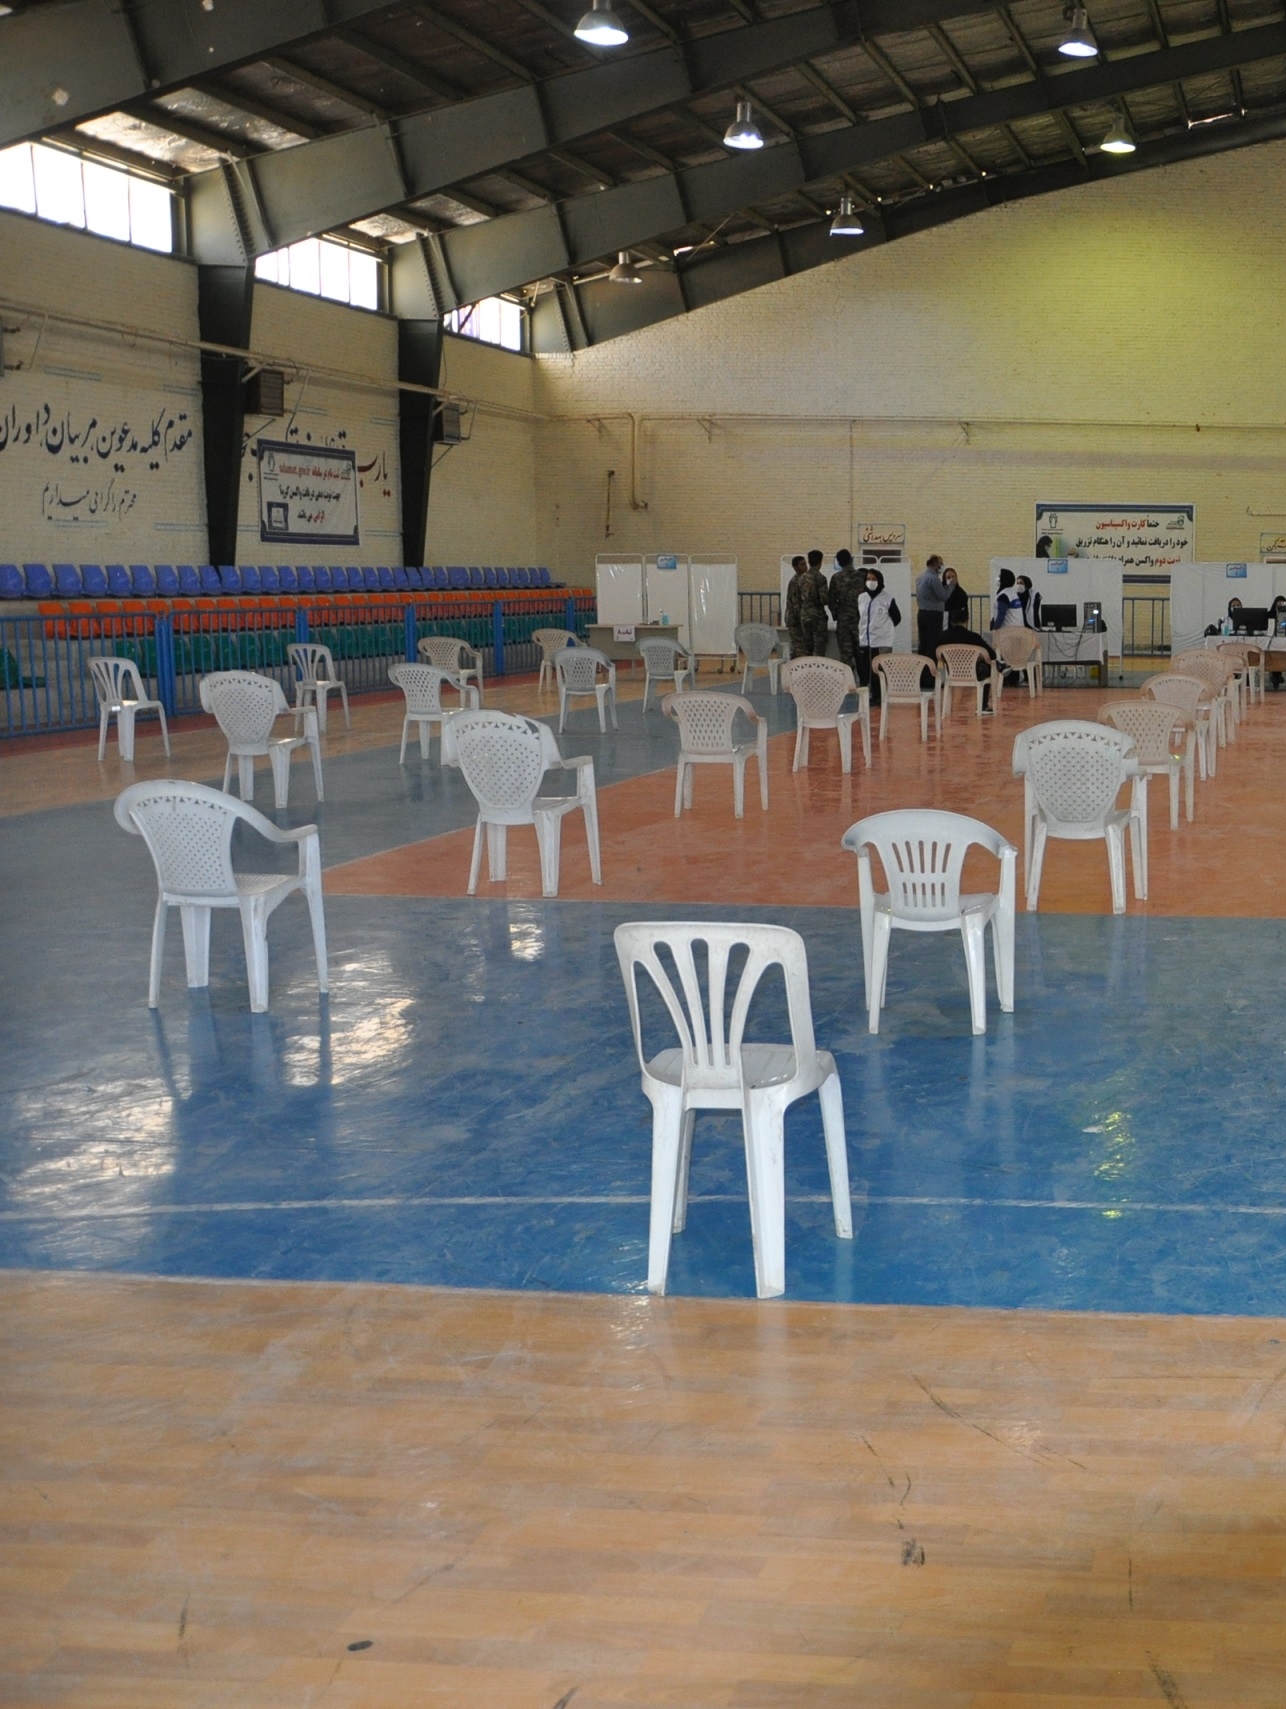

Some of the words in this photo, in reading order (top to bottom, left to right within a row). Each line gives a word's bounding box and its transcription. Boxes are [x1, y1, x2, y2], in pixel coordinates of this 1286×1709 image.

[140, 408, 165, 470] کلیه
[164, 413, 193, 462] مقدم
[1095, 518, 1130, 530] واکسیناسیون
[1131, 517, 1147, 530] کارت
[1075, 536, 1092, 548] تزریق
[1092, 536, 1109, 548] هنگام
[1116, 535, 1125, 548] آن
[1148, 536, 1168, 549] دریافت
[1176, 538, 1188, 549] خود
[1135, 555, 1154, 567] واکسن
[1154, 556, 1166, 567] دوم
